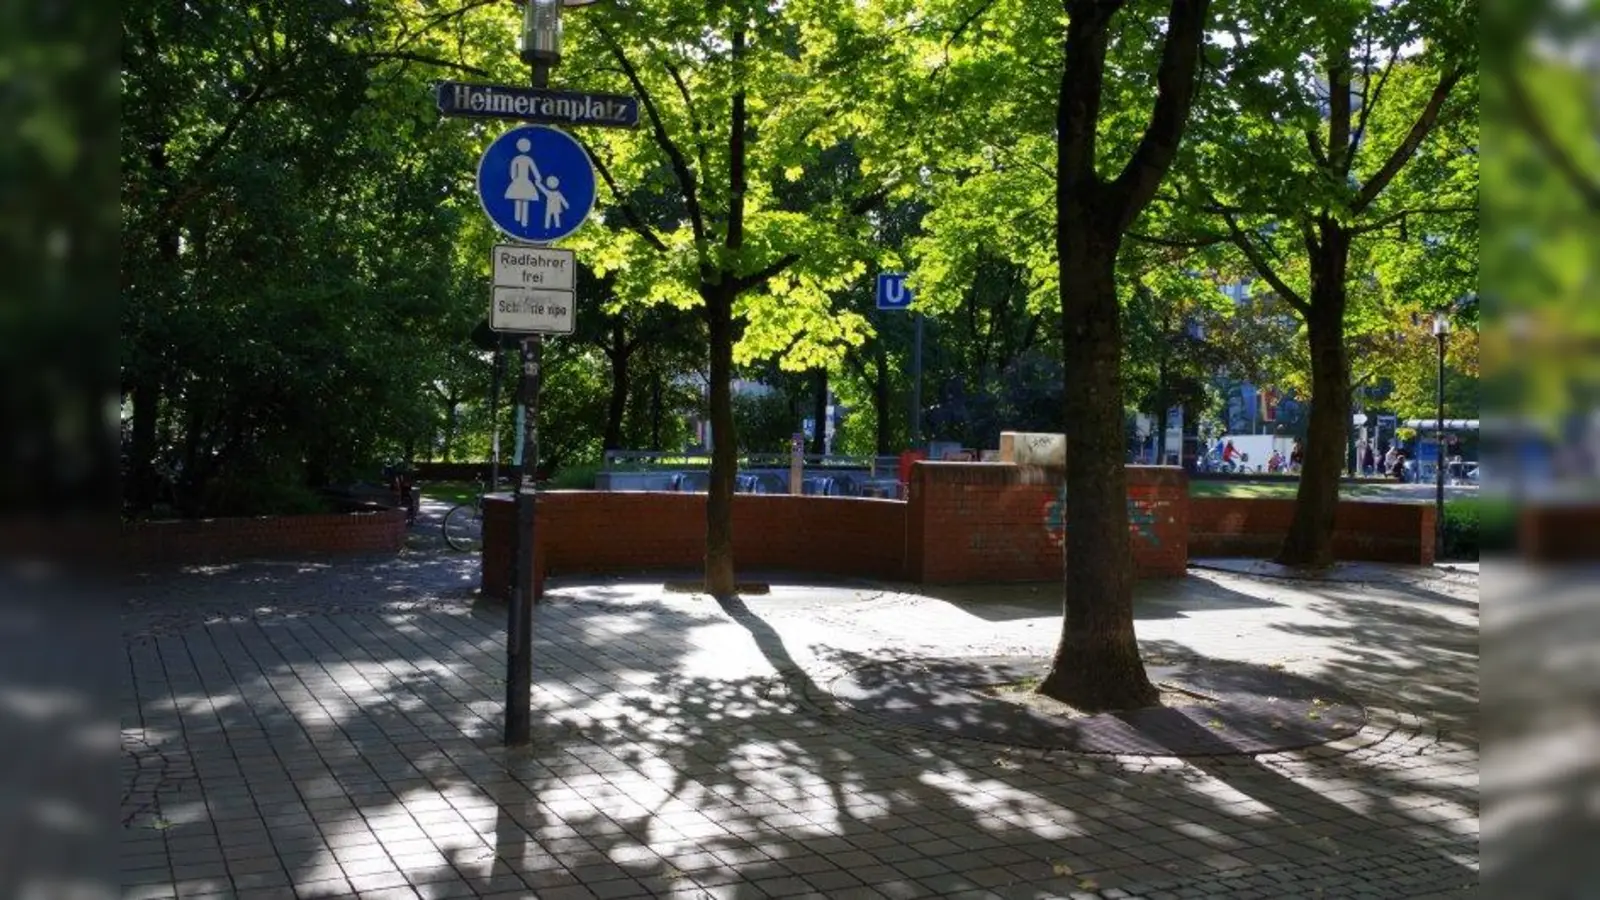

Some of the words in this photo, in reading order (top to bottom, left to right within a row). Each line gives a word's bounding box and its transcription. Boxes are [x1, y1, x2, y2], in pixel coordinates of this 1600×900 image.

[454, 85, 627, 121] Heimeranplatz
[501, 252, 566, 268] Radfahrer
[522, 270, 544, 284] frei
[886, 278, 905, 303] U
